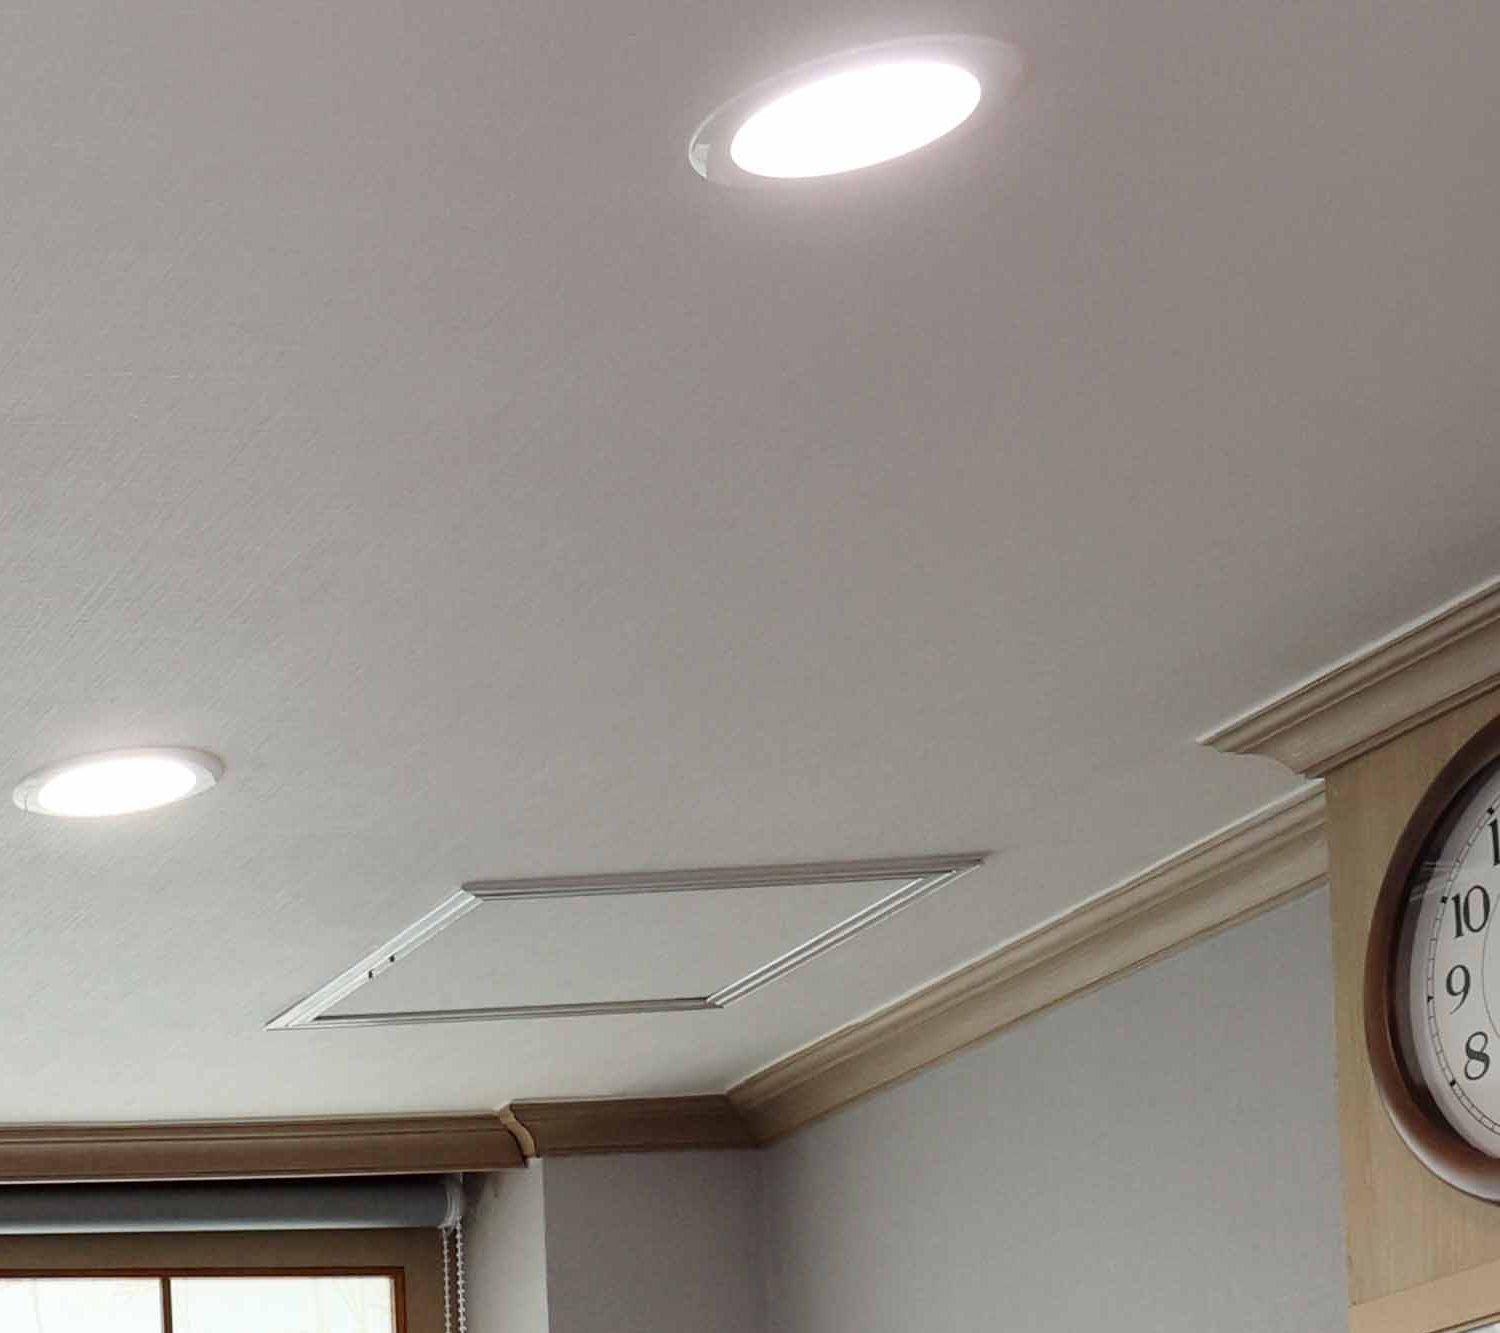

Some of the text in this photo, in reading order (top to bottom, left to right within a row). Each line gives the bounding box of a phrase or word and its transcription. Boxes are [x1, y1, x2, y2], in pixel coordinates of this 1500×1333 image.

[1451, 885, 1491, 938] 10
[1446, 964, 1471, 1015] 9
[1464, 1031, 1490, 1080] 8
